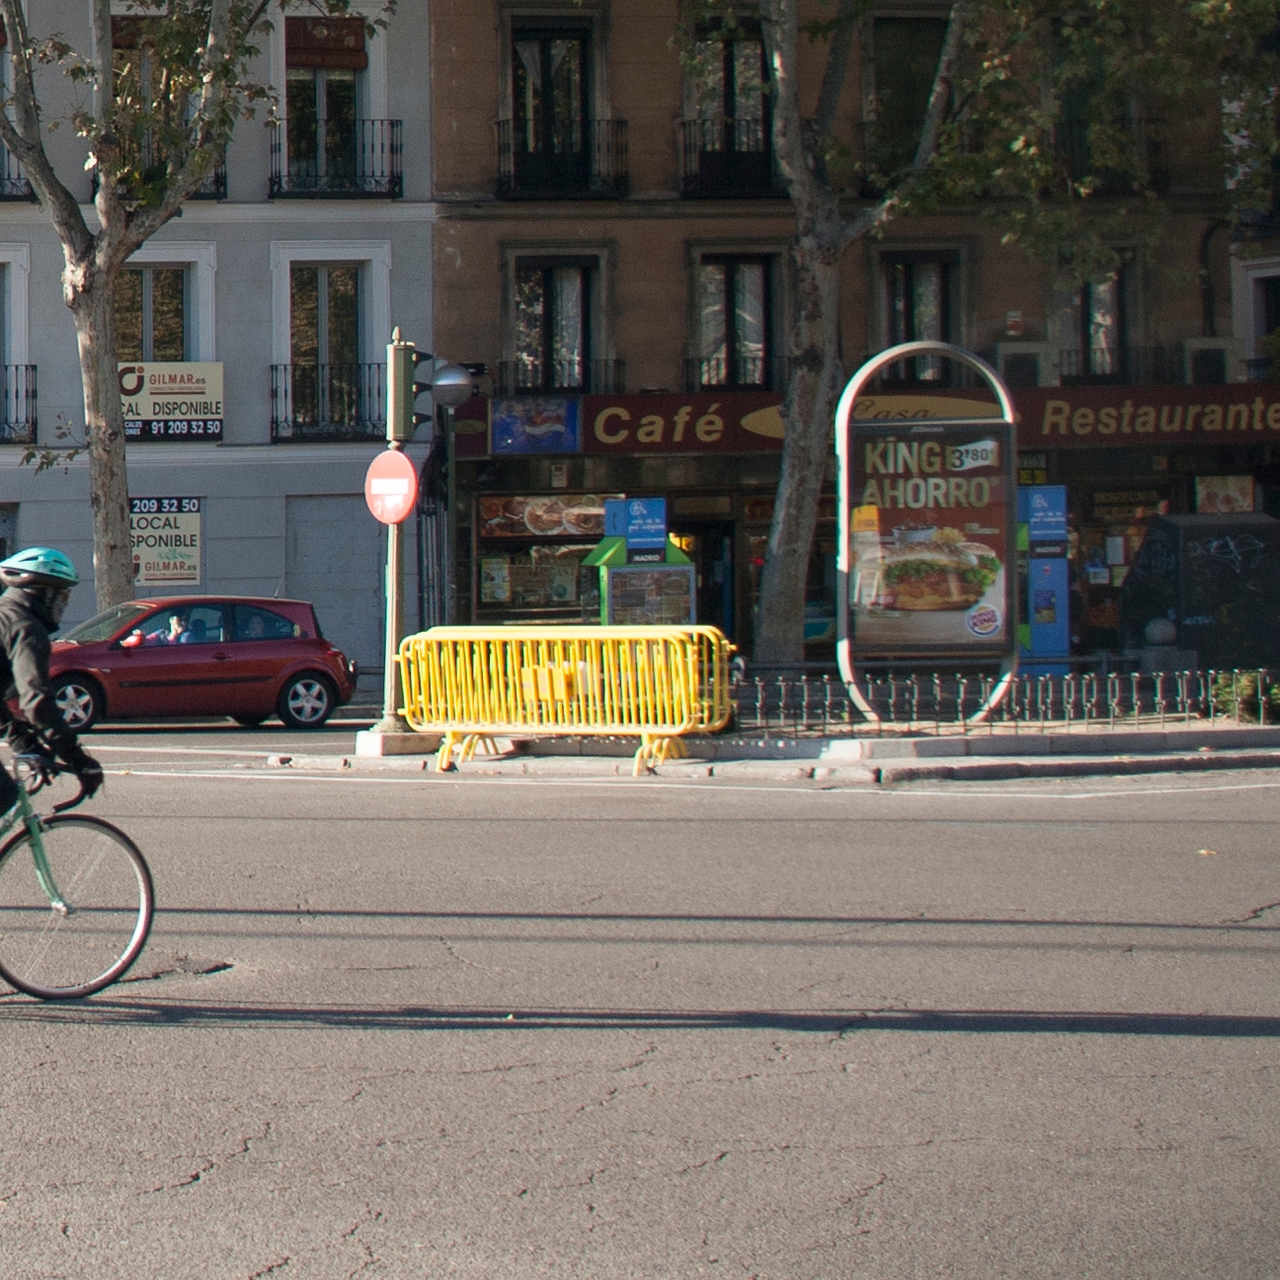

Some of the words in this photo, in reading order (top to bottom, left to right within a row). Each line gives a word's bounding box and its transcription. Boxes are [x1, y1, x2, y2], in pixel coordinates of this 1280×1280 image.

[149, 374, 206, 385] GILMAR.es
[152, 401, 222, 416] DISPONIBLE
[1041, 396, 1280, 436] Restaurante
[151, 421, 164, 434] 91
[167, 421, 188, 434] 209
[190, 421, 204, 433] 32
[207, 421, 220, 433] 50
[593, 403, 725, 445] Café
[864, 438, 941, 474] KING
[132, 499, 158, 512] 209
[161, 499, 178, 512] 32
[181, 499, 199, 511] 50
[130, 516, 181, 530] LOCAL
[130, 533, 198, 548] SPONIBLE
